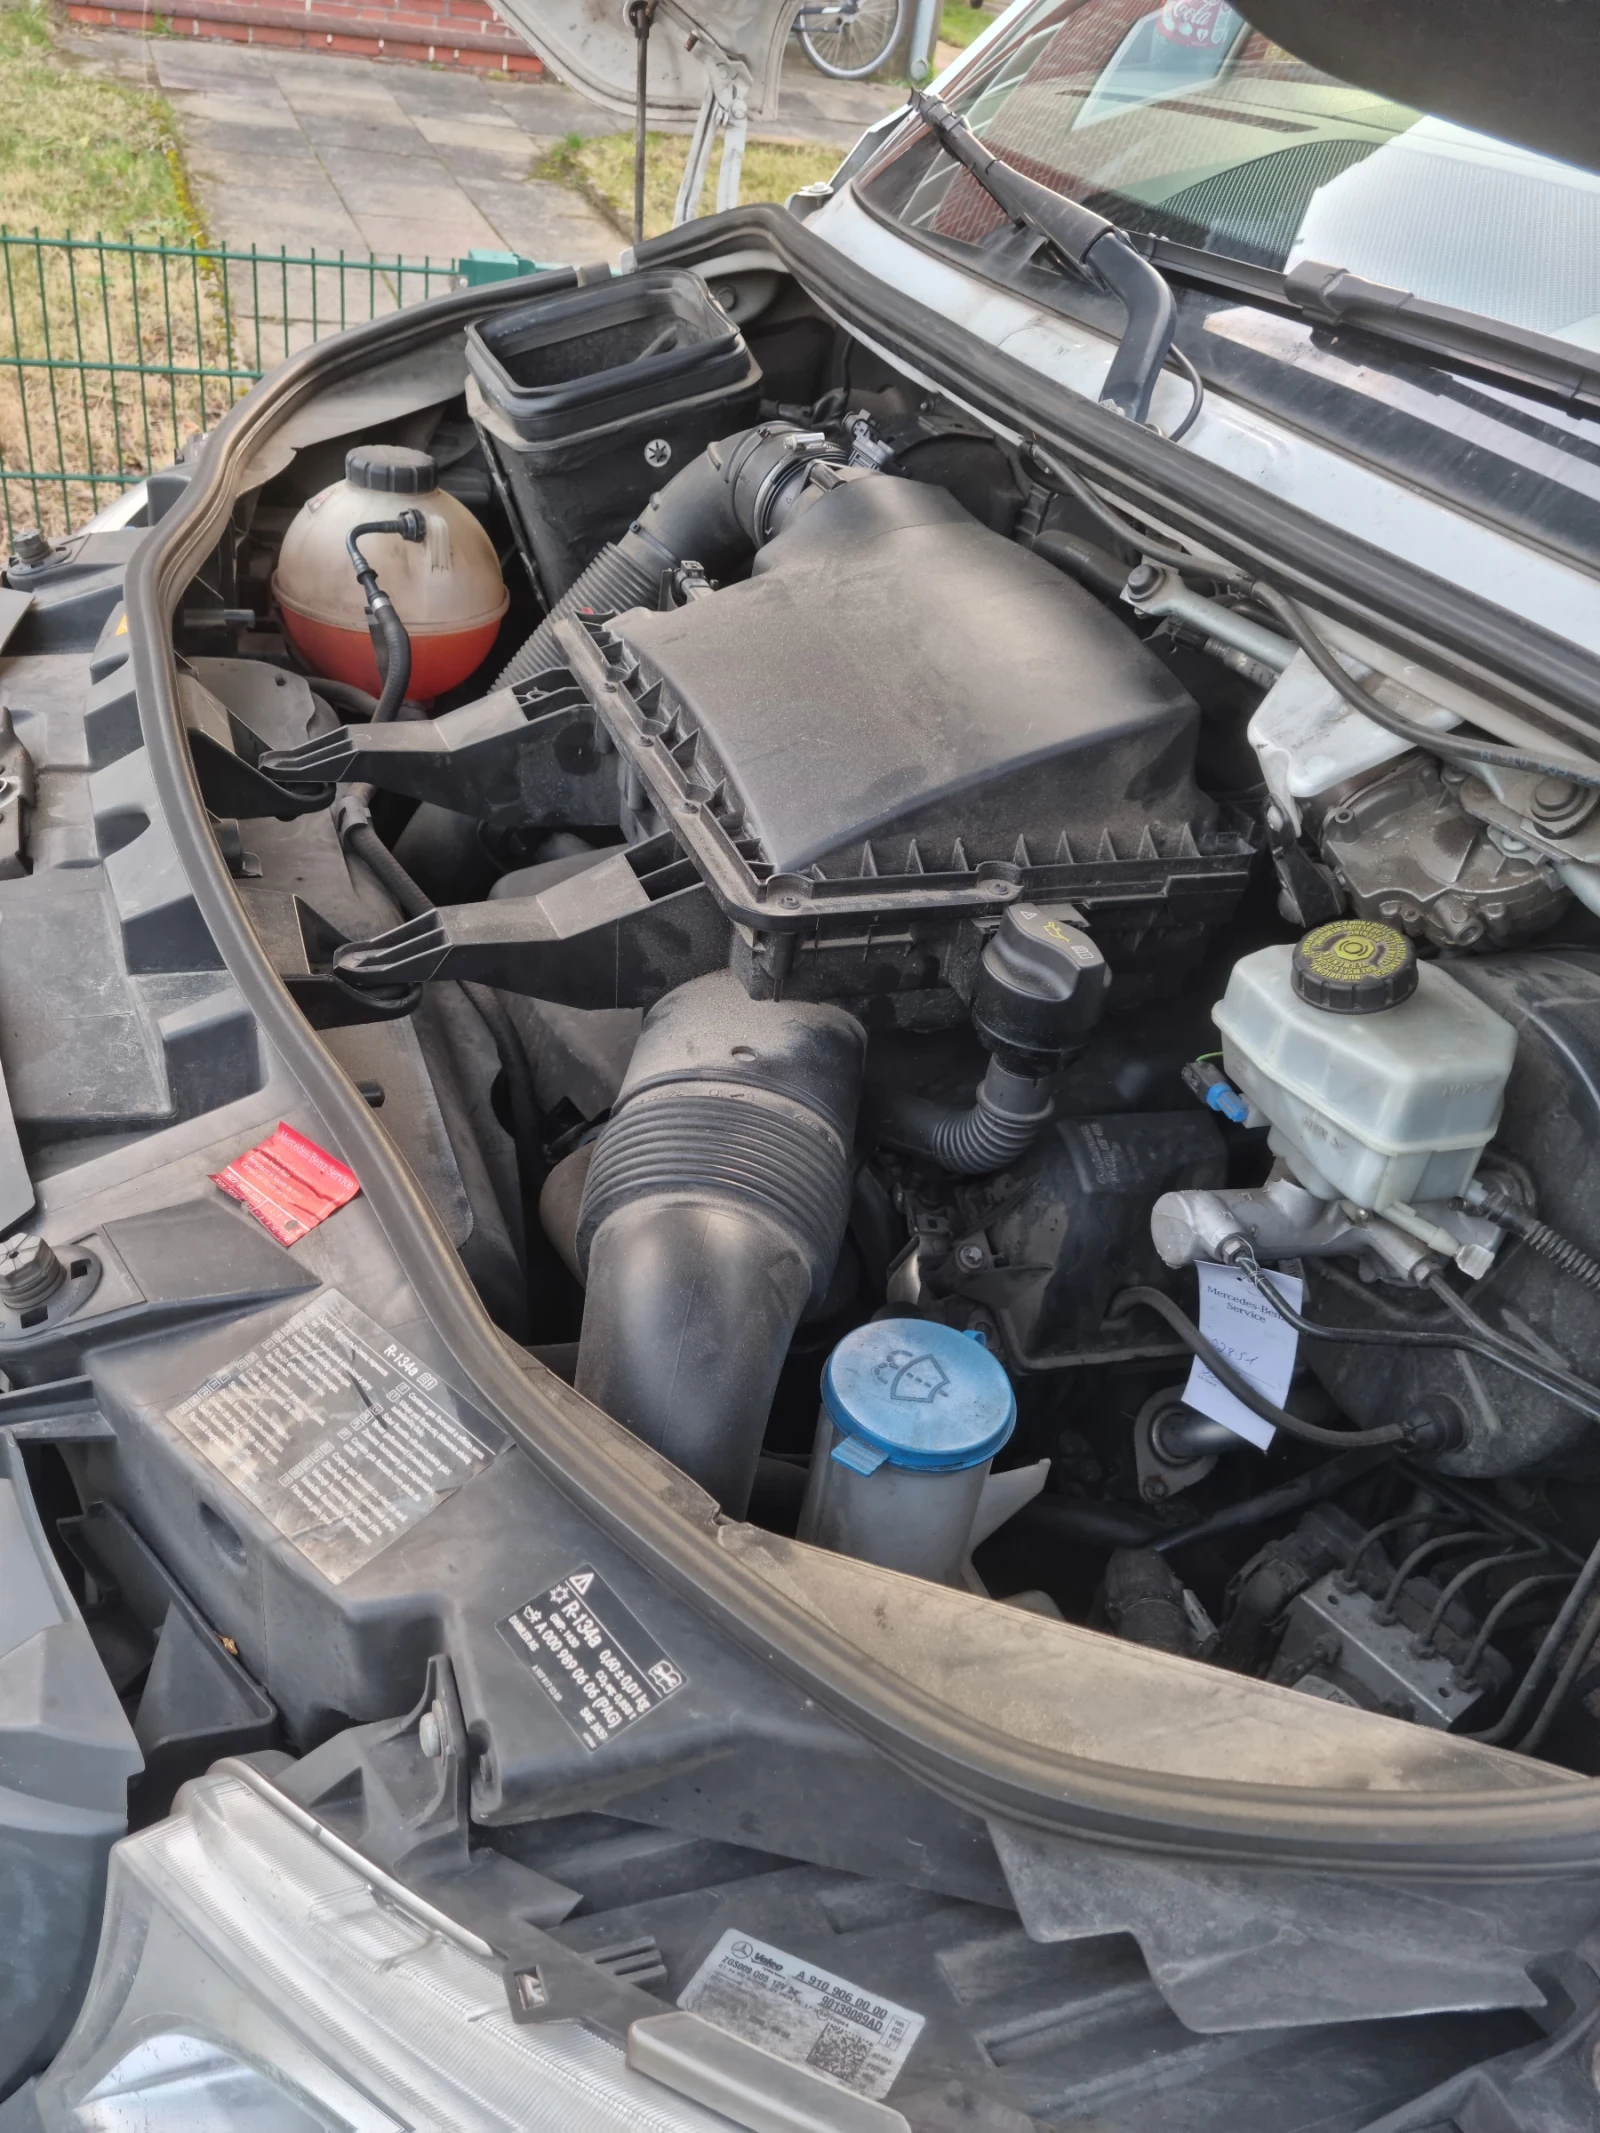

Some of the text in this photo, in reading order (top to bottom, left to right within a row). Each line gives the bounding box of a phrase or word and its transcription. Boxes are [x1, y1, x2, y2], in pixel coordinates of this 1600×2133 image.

[279, 1130, 328, 1174] Mercedes-Benz
[328, 1166, 354, 1190] Service
[1226, 1302, 1266, 1323] Service
[384, 1344, 418, 1377] R-134a
[508, 1615, 533, 1643] DAIMLER
[526, 1639, 540, 1652] AG
[579, 1706, 596, 1724] SAE
[562, 1600, 602, 1648] R-134a
[635, 1693, 651, 1713] kg
[563, 1630, 580, 1649] 1430
[534, 1622, 622, 1729] A 000 989 06 06 (PAG)
[722, 1955, 753, 1975] ZGS009
[819, 1996, 883, 2032] 90139089AD
[794, 1970, 806, 1981] A
[807, 1975, 830, 1992] 910
[831, 1986, 853, 2003] 906
[854, 1997, 871, 2011] 00
[872, 2005, 888, 2019] 00
